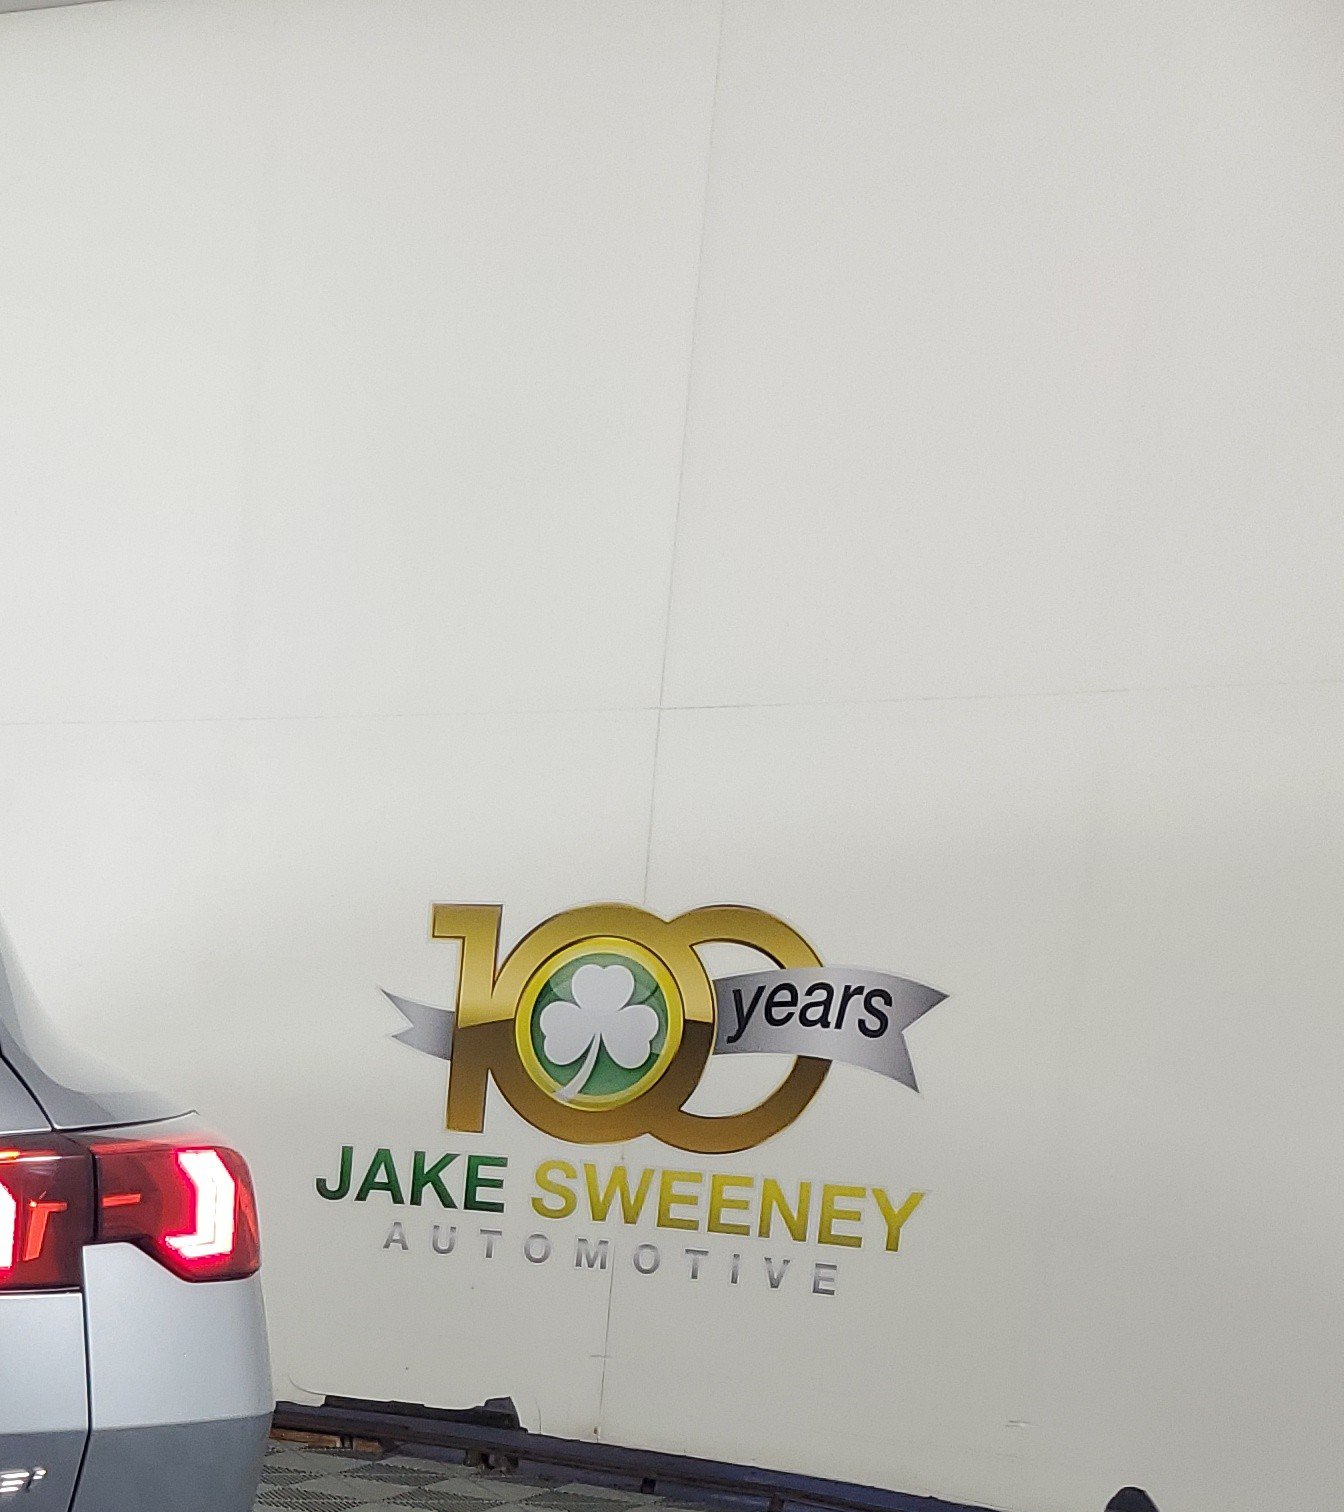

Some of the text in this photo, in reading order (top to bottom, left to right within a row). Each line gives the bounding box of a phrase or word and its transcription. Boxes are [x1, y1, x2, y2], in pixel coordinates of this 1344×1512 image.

[725, 981, 893, 1044] years
[315, 1145, 927, 1252] JAKE SWEENEY
[382, 1221, 839, 1296] AUTOMOTIVE
